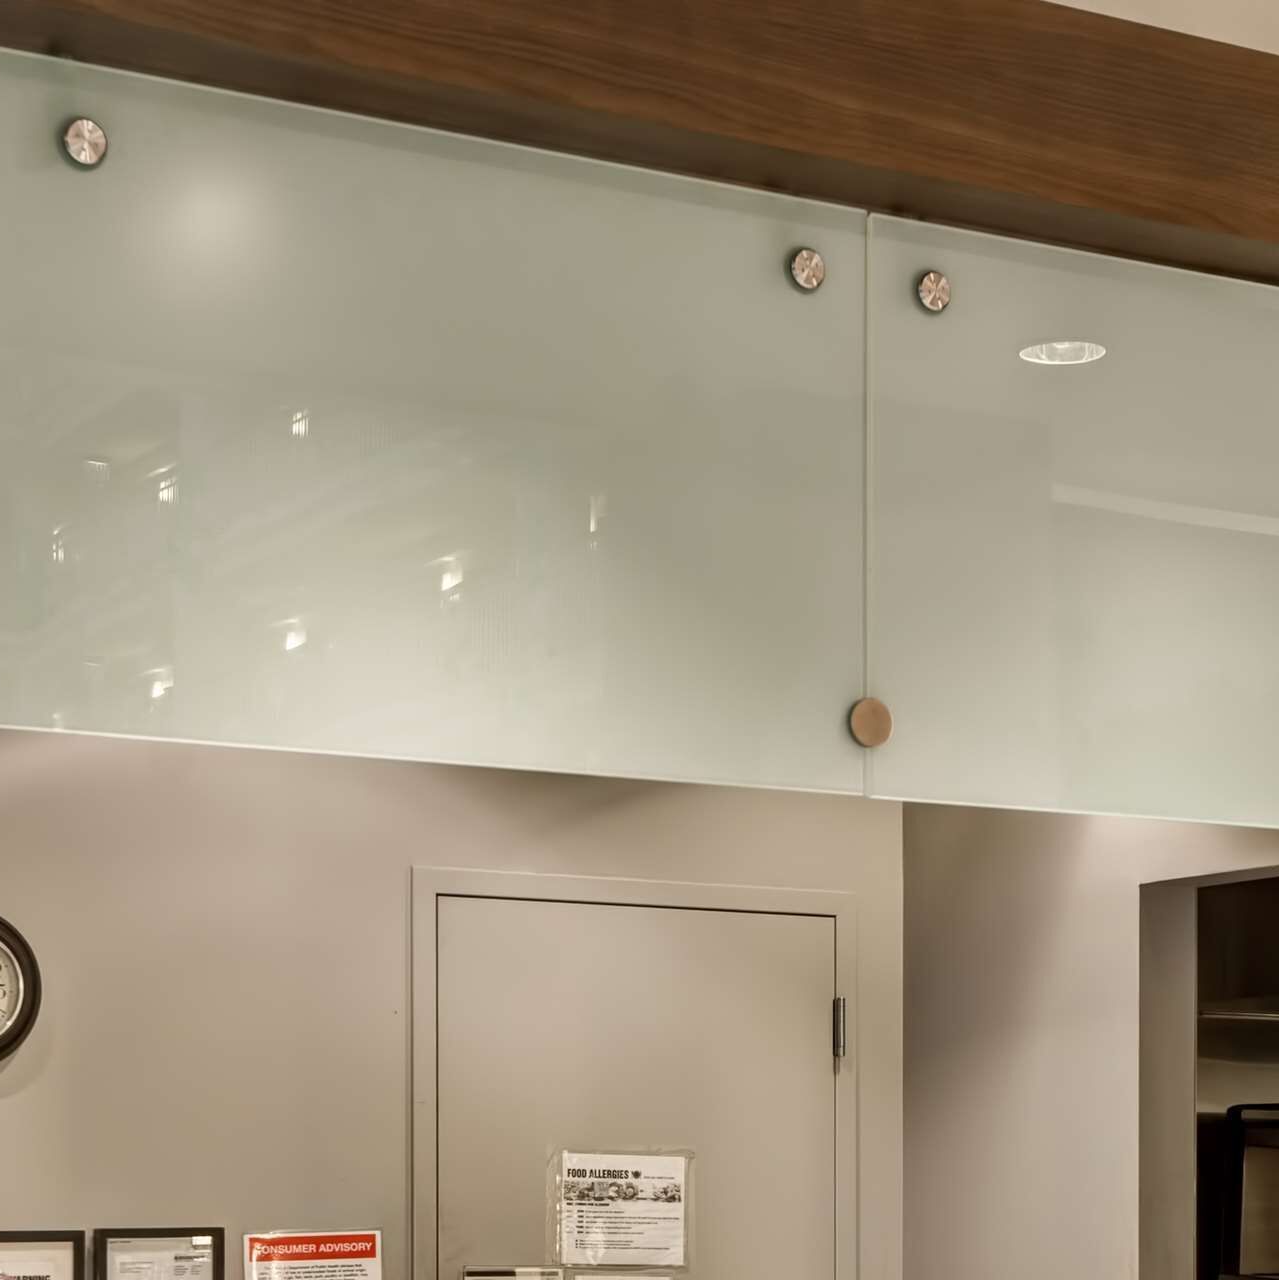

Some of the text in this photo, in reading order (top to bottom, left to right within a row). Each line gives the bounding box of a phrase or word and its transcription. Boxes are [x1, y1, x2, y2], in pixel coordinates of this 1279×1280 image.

[567, 1168, 629, 1179] FOOD ALLERGIES
[319, 1242, 373, 1252] ADVISORY
